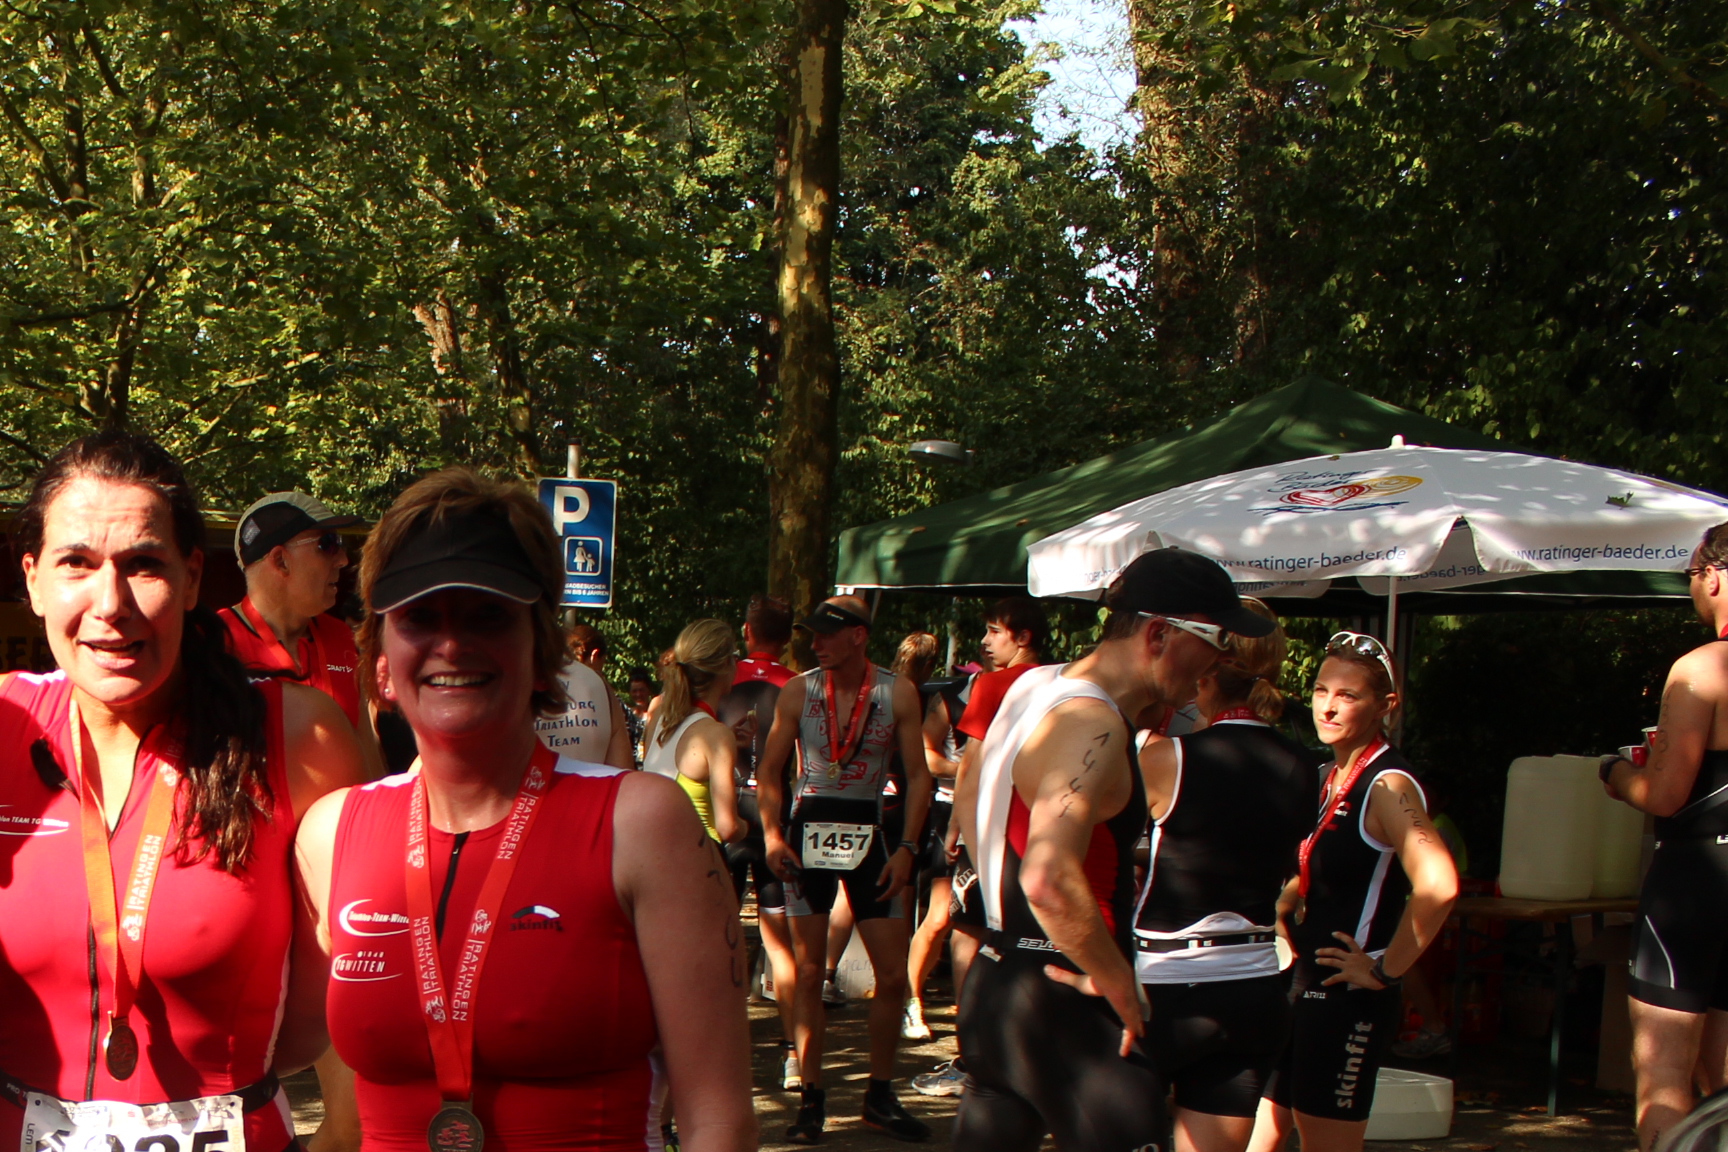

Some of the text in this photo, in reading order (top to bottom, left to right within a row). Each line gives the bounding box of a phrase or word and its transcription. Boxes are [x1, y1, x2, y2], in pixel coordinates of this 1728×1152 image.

[553, 485, 590, 536] P
[497, 796, 527, 860] TRIATHLON
[504, 797, 537, 860] RATINGEN
[807, 832, 870, 851] 1457
[414, 919, 432, 990] RATINGEN
[422, 916, 440, 989] TRIATHLON
[452, 941, 475, 1020] TRIATHLON
[460, 943, 483, 1021] RATINGEN
[1334, 1021, 1372, 1109] skinfit
